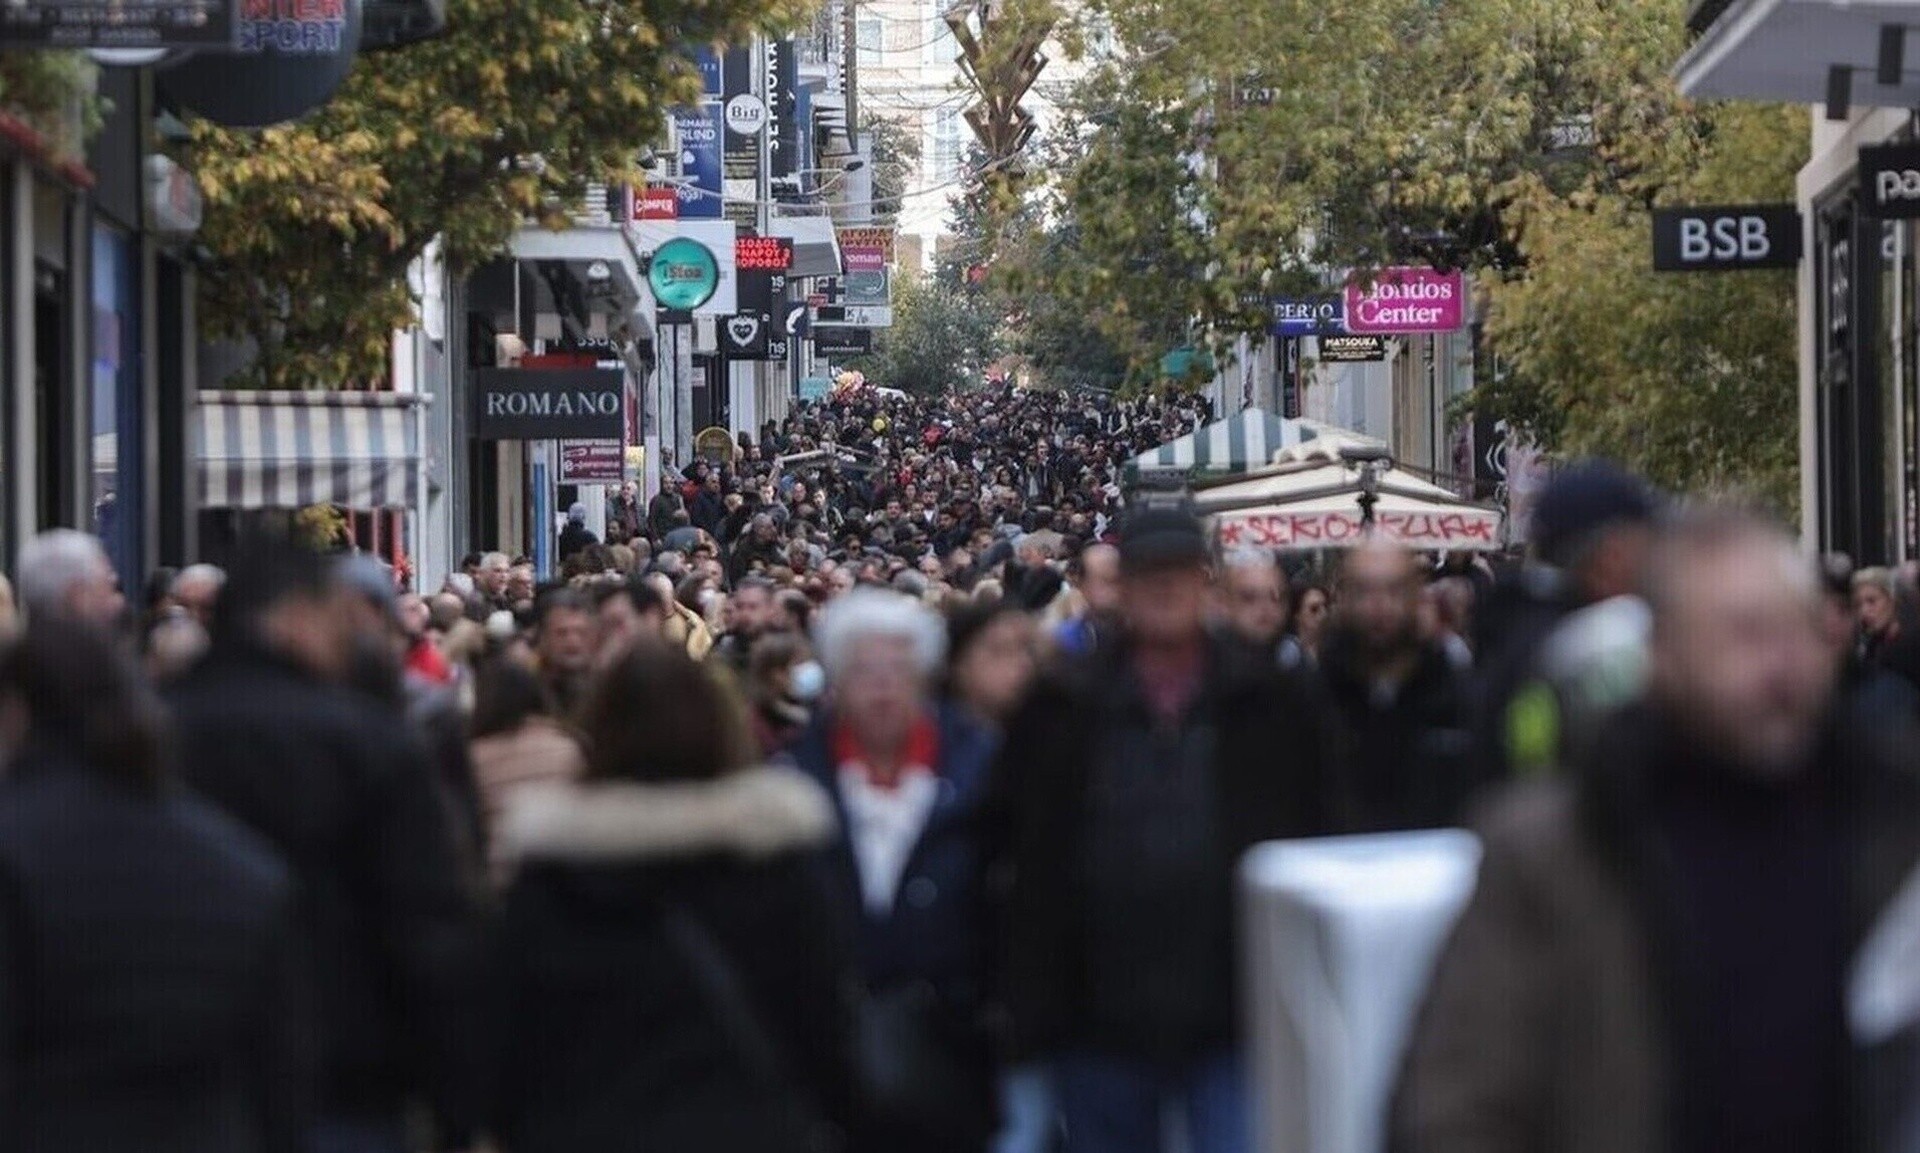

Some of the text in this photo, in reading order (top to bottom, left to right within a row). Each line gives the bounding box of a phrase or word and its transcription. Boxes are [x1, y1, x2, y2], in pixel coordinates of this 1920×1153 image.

[239, 20, 342, 51] SPORT
[1680, 215, 1771, 260] BSB
[1357, 301, 1443, 324] Center
[486, 391, 620, 416] ROMANO
